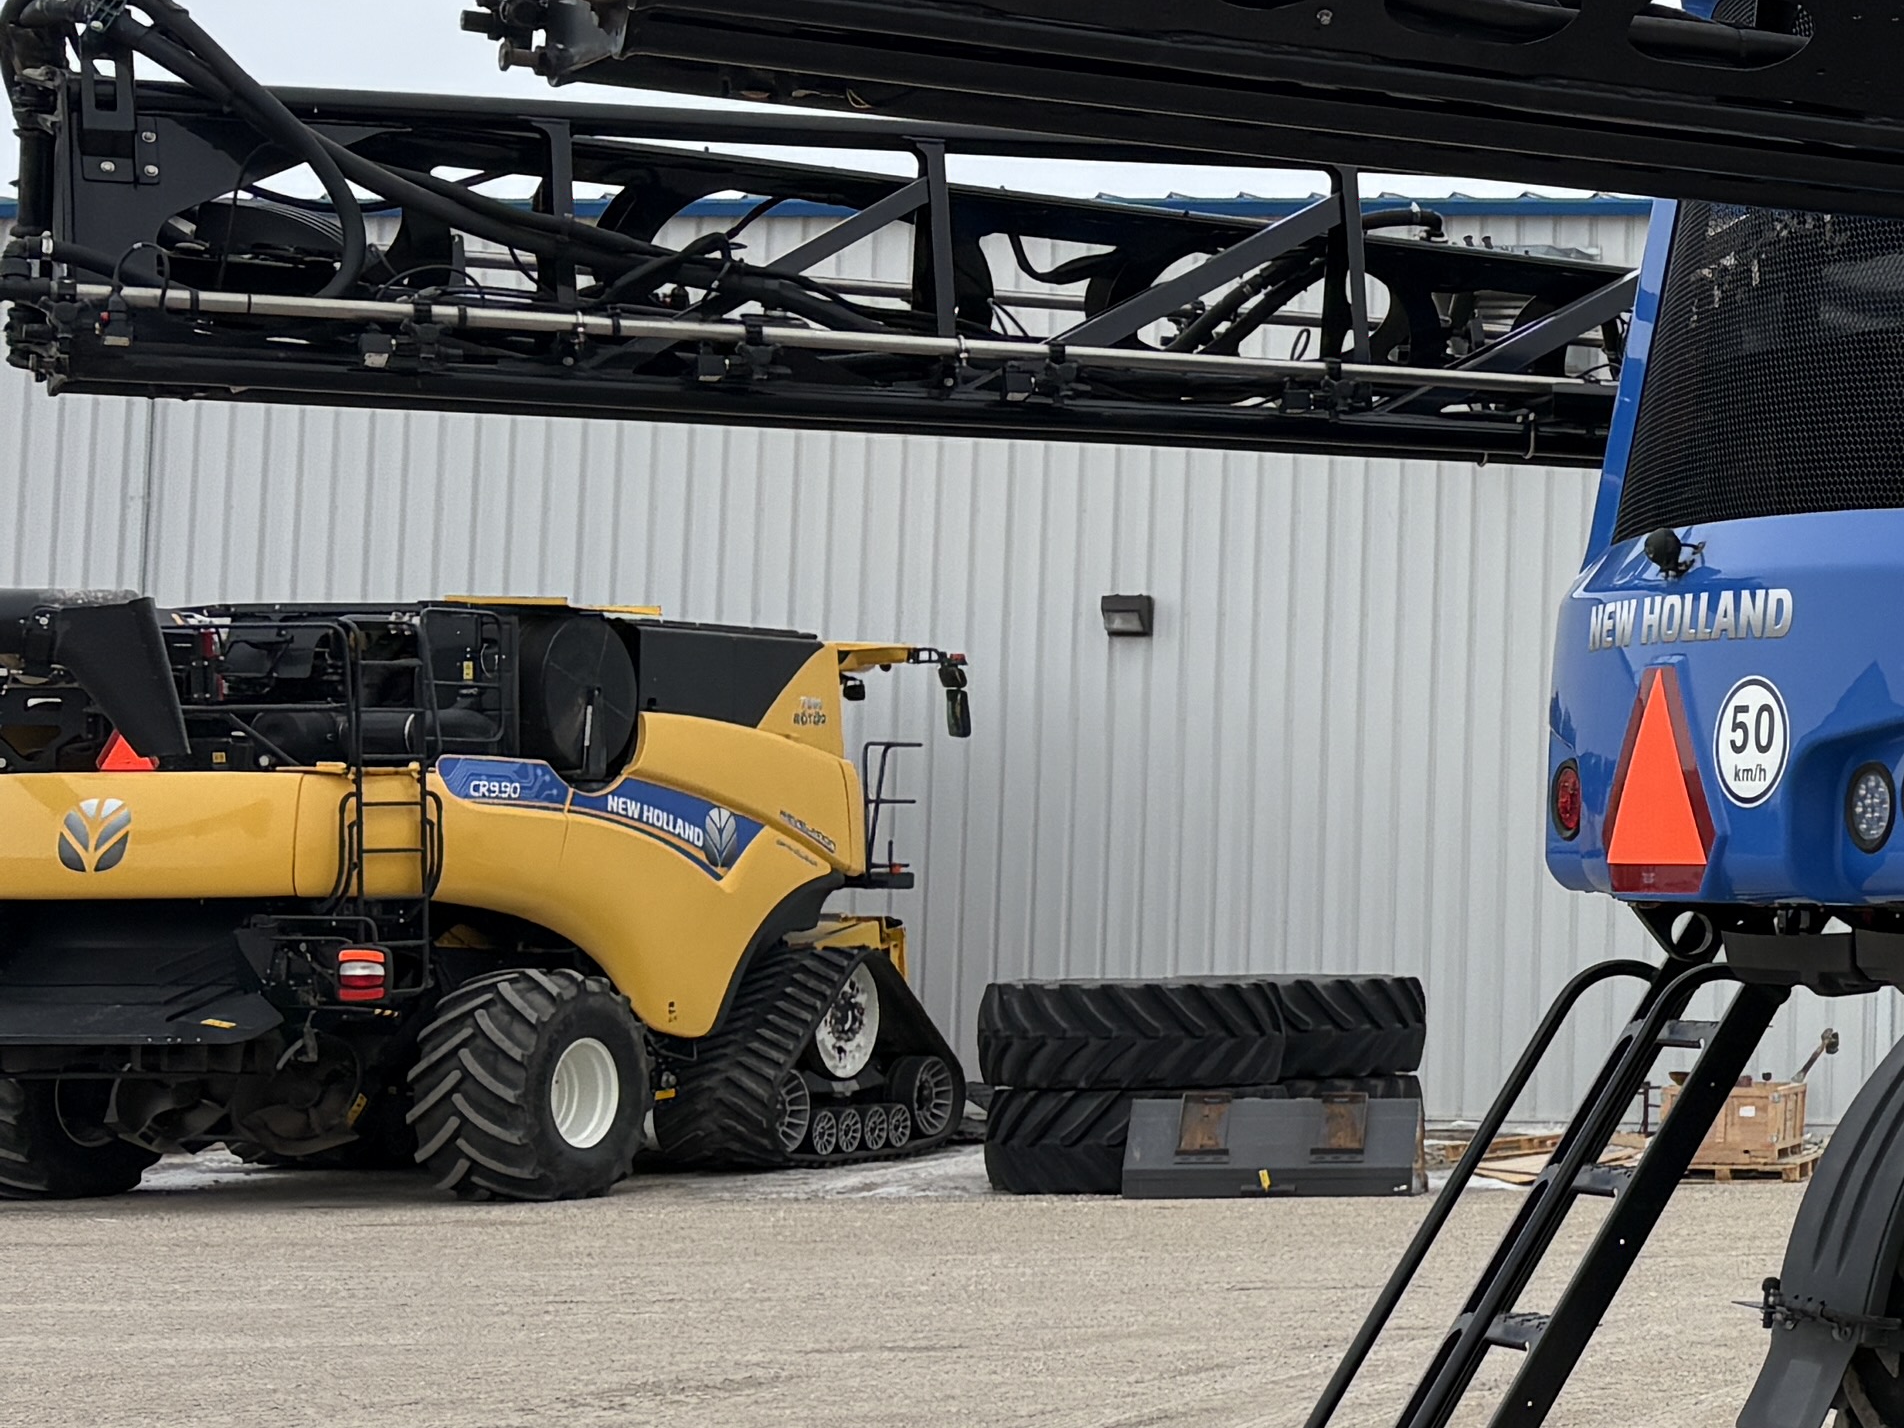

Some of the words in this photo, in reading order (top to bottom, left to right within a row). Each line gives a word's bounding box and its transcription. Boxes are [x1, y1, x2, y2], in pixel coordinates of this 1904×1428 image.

[1589, 599, 1637, 651] NEW
[1641, 588, 1793, 645] HOLLAND
[1730, 703, 1775, 754] 50
[469, 780, 521, 798] CR9.90
[1734, 764, 1767, 782] km/h
[607, 794, 641, 819] NEW
[642, 803, 704, 847] HOLLAND
